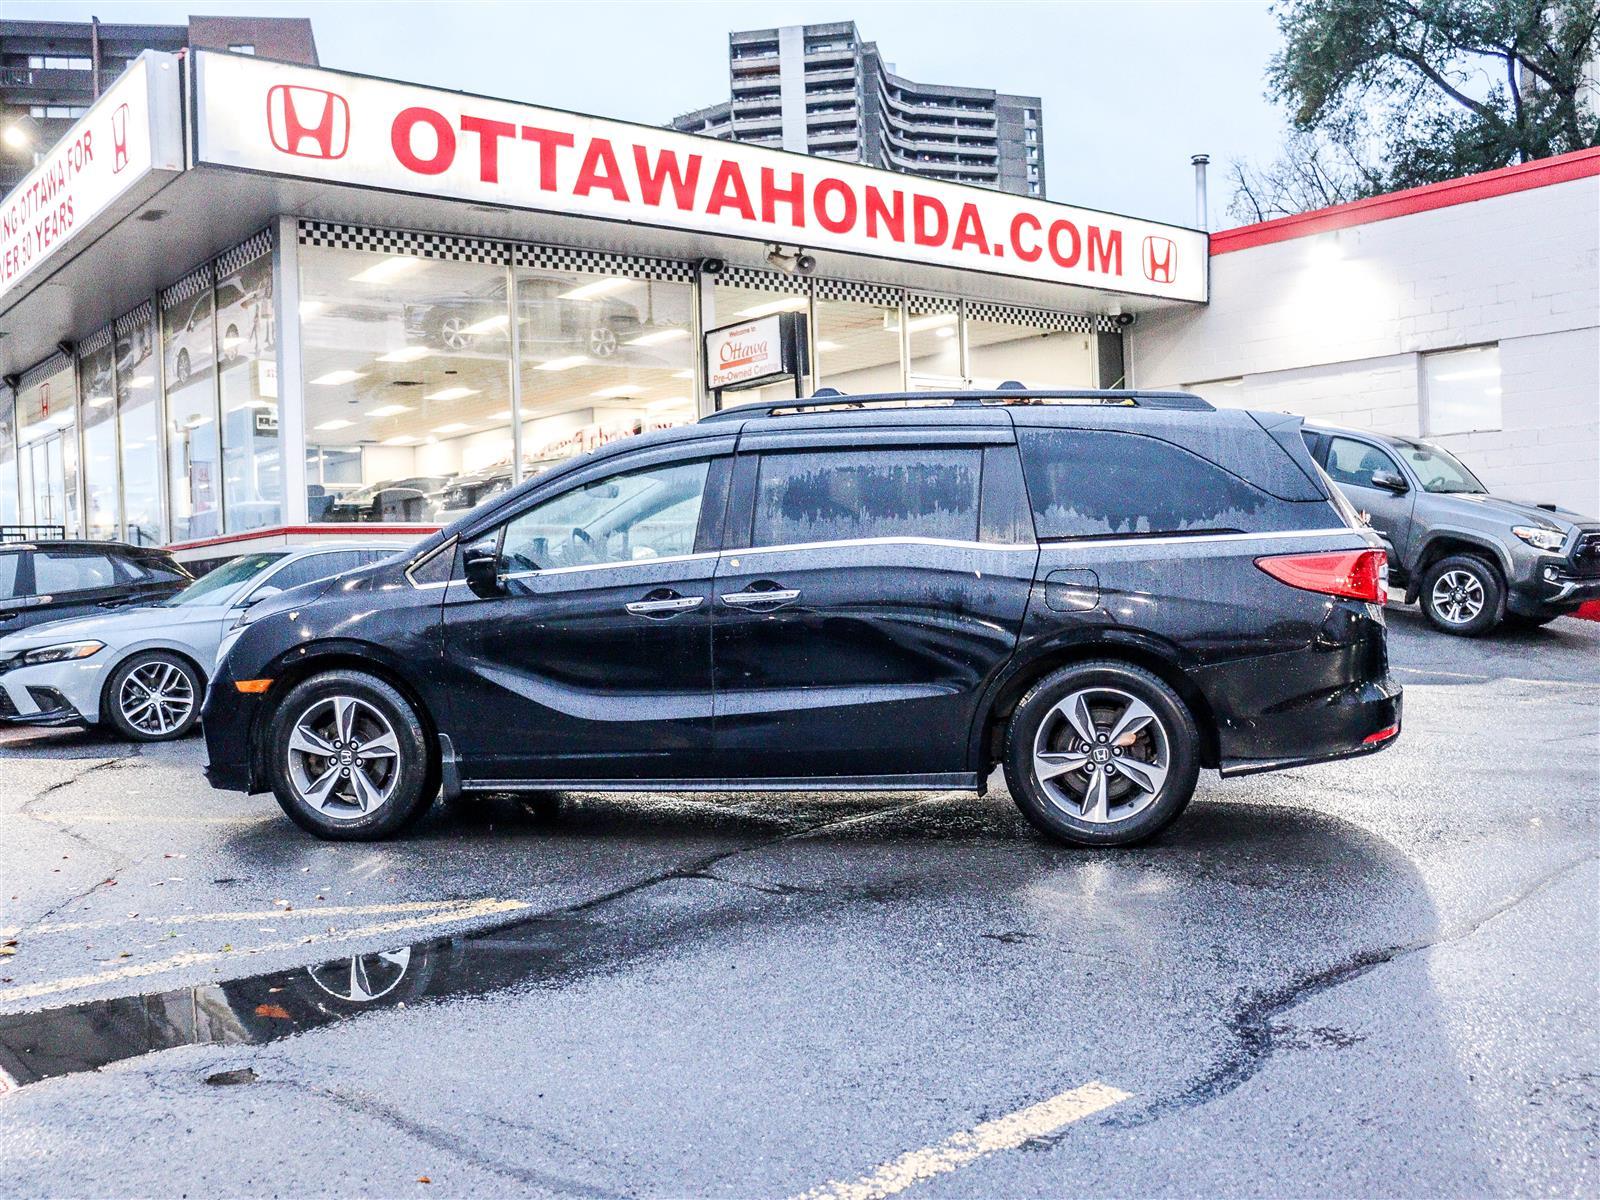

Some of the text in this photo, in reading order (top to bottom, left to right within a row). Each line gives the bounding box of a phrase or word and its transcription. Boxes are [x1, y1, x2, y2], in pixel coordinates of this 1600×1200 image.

[20, 160, 66, 224] OTTAWA
[67, 130, 93, 180] FOR
[391, 106, 1122, 276] OTTAWAHONDA.COM
[23, 231, 32, 266] 50
[35, 195, 74, 252] YEARS
[713, 368, 752, 384] Pre-Owned
[720, 341, 768, 362] Ottawa
